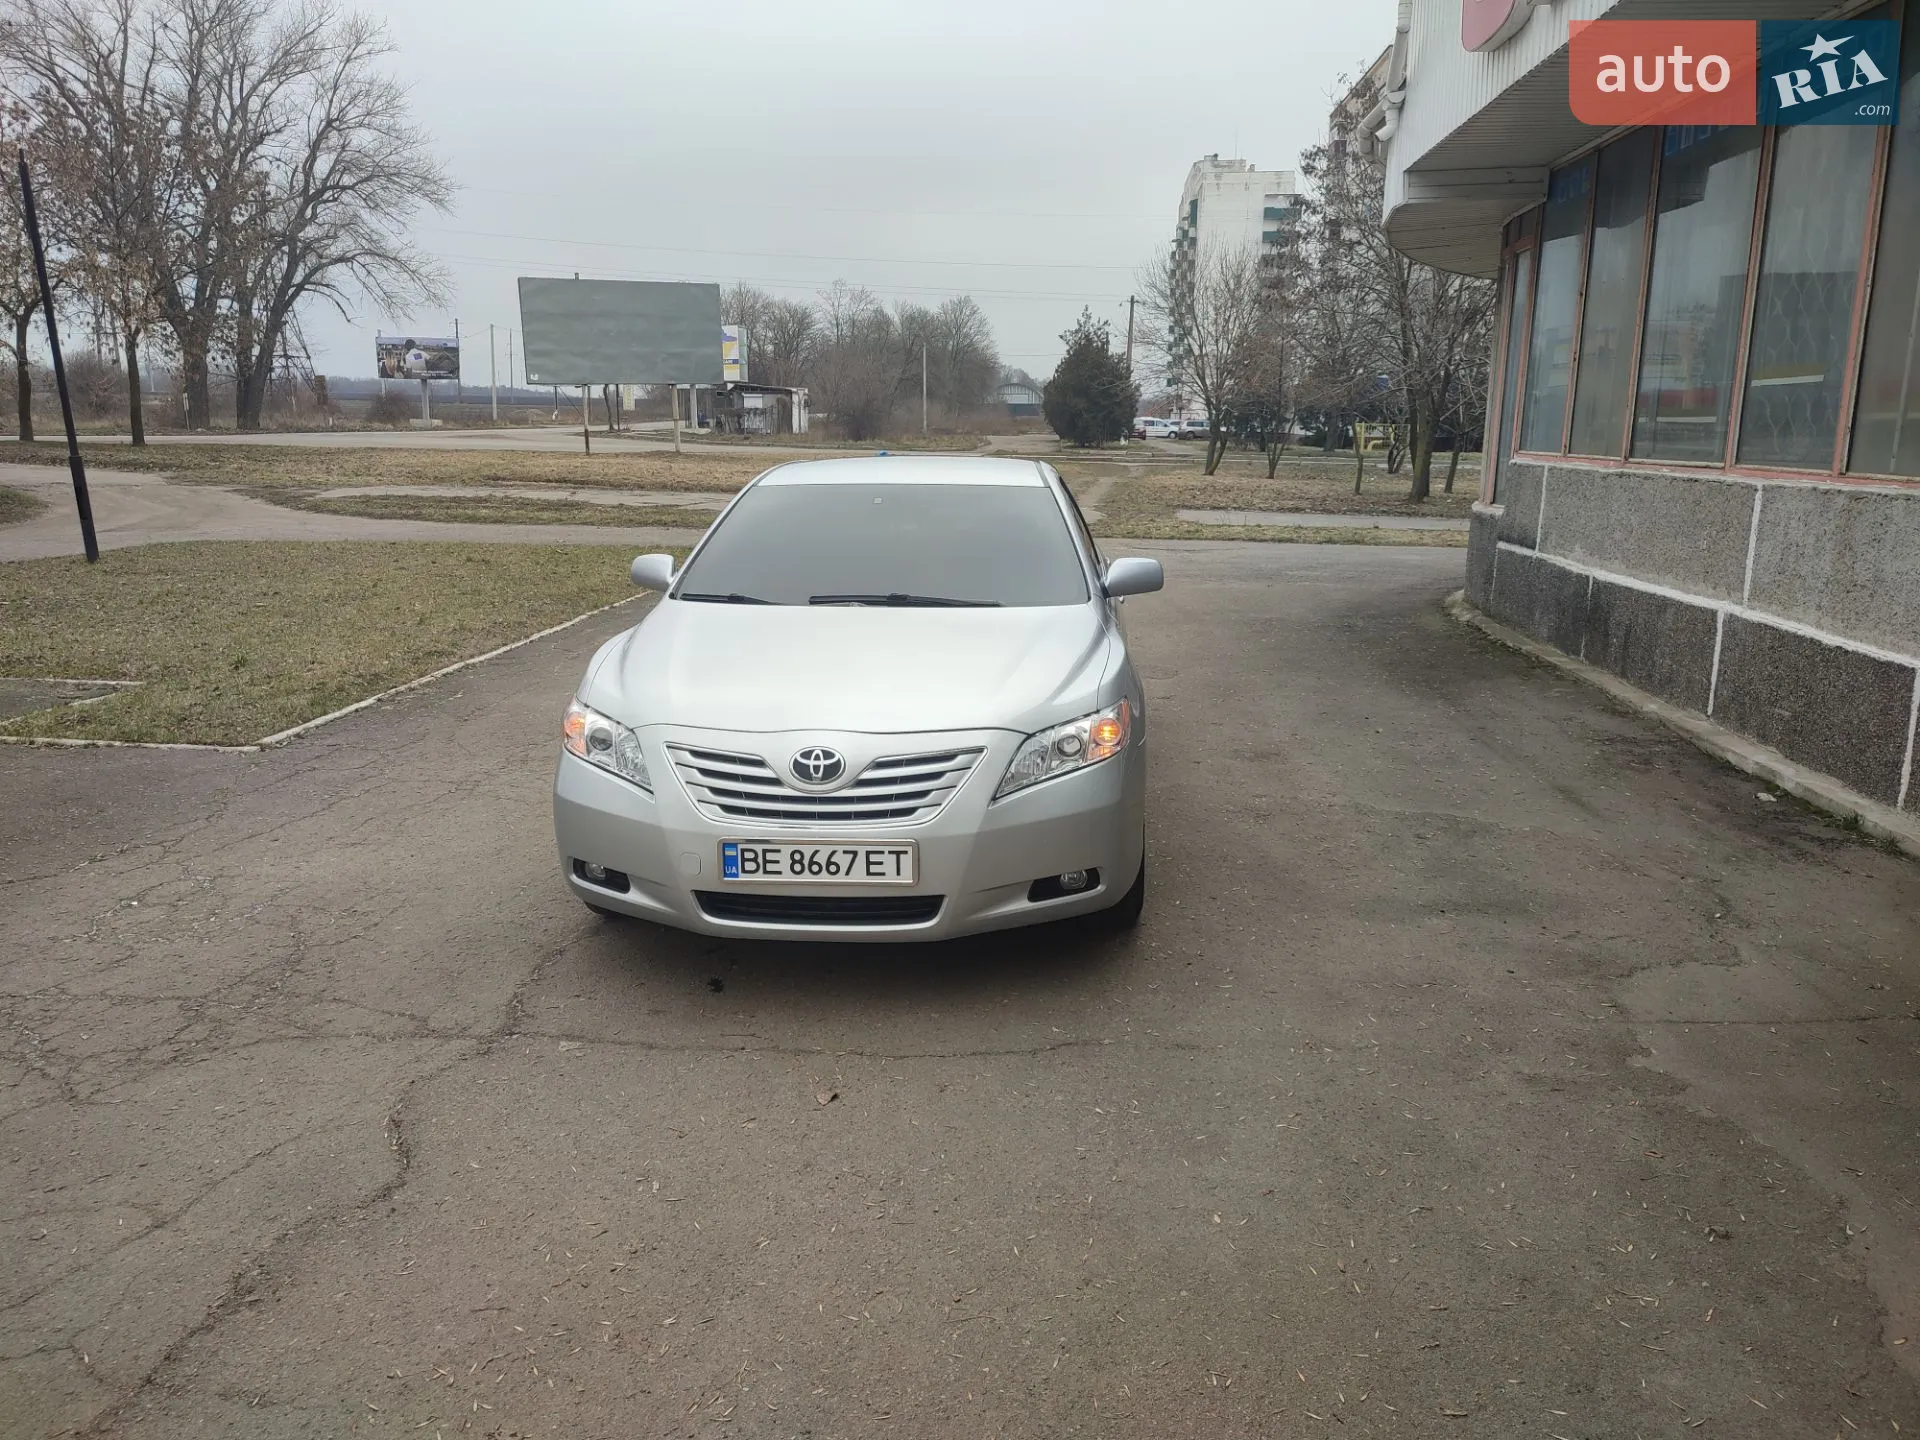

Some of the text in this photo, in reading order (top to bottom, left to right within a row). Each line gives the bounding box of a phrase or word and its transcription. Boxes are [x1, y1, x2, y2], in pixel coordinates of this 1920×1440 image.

[725, 865, 738, 875] UA
[740, 848, 909, 877] BE 8667 ET
